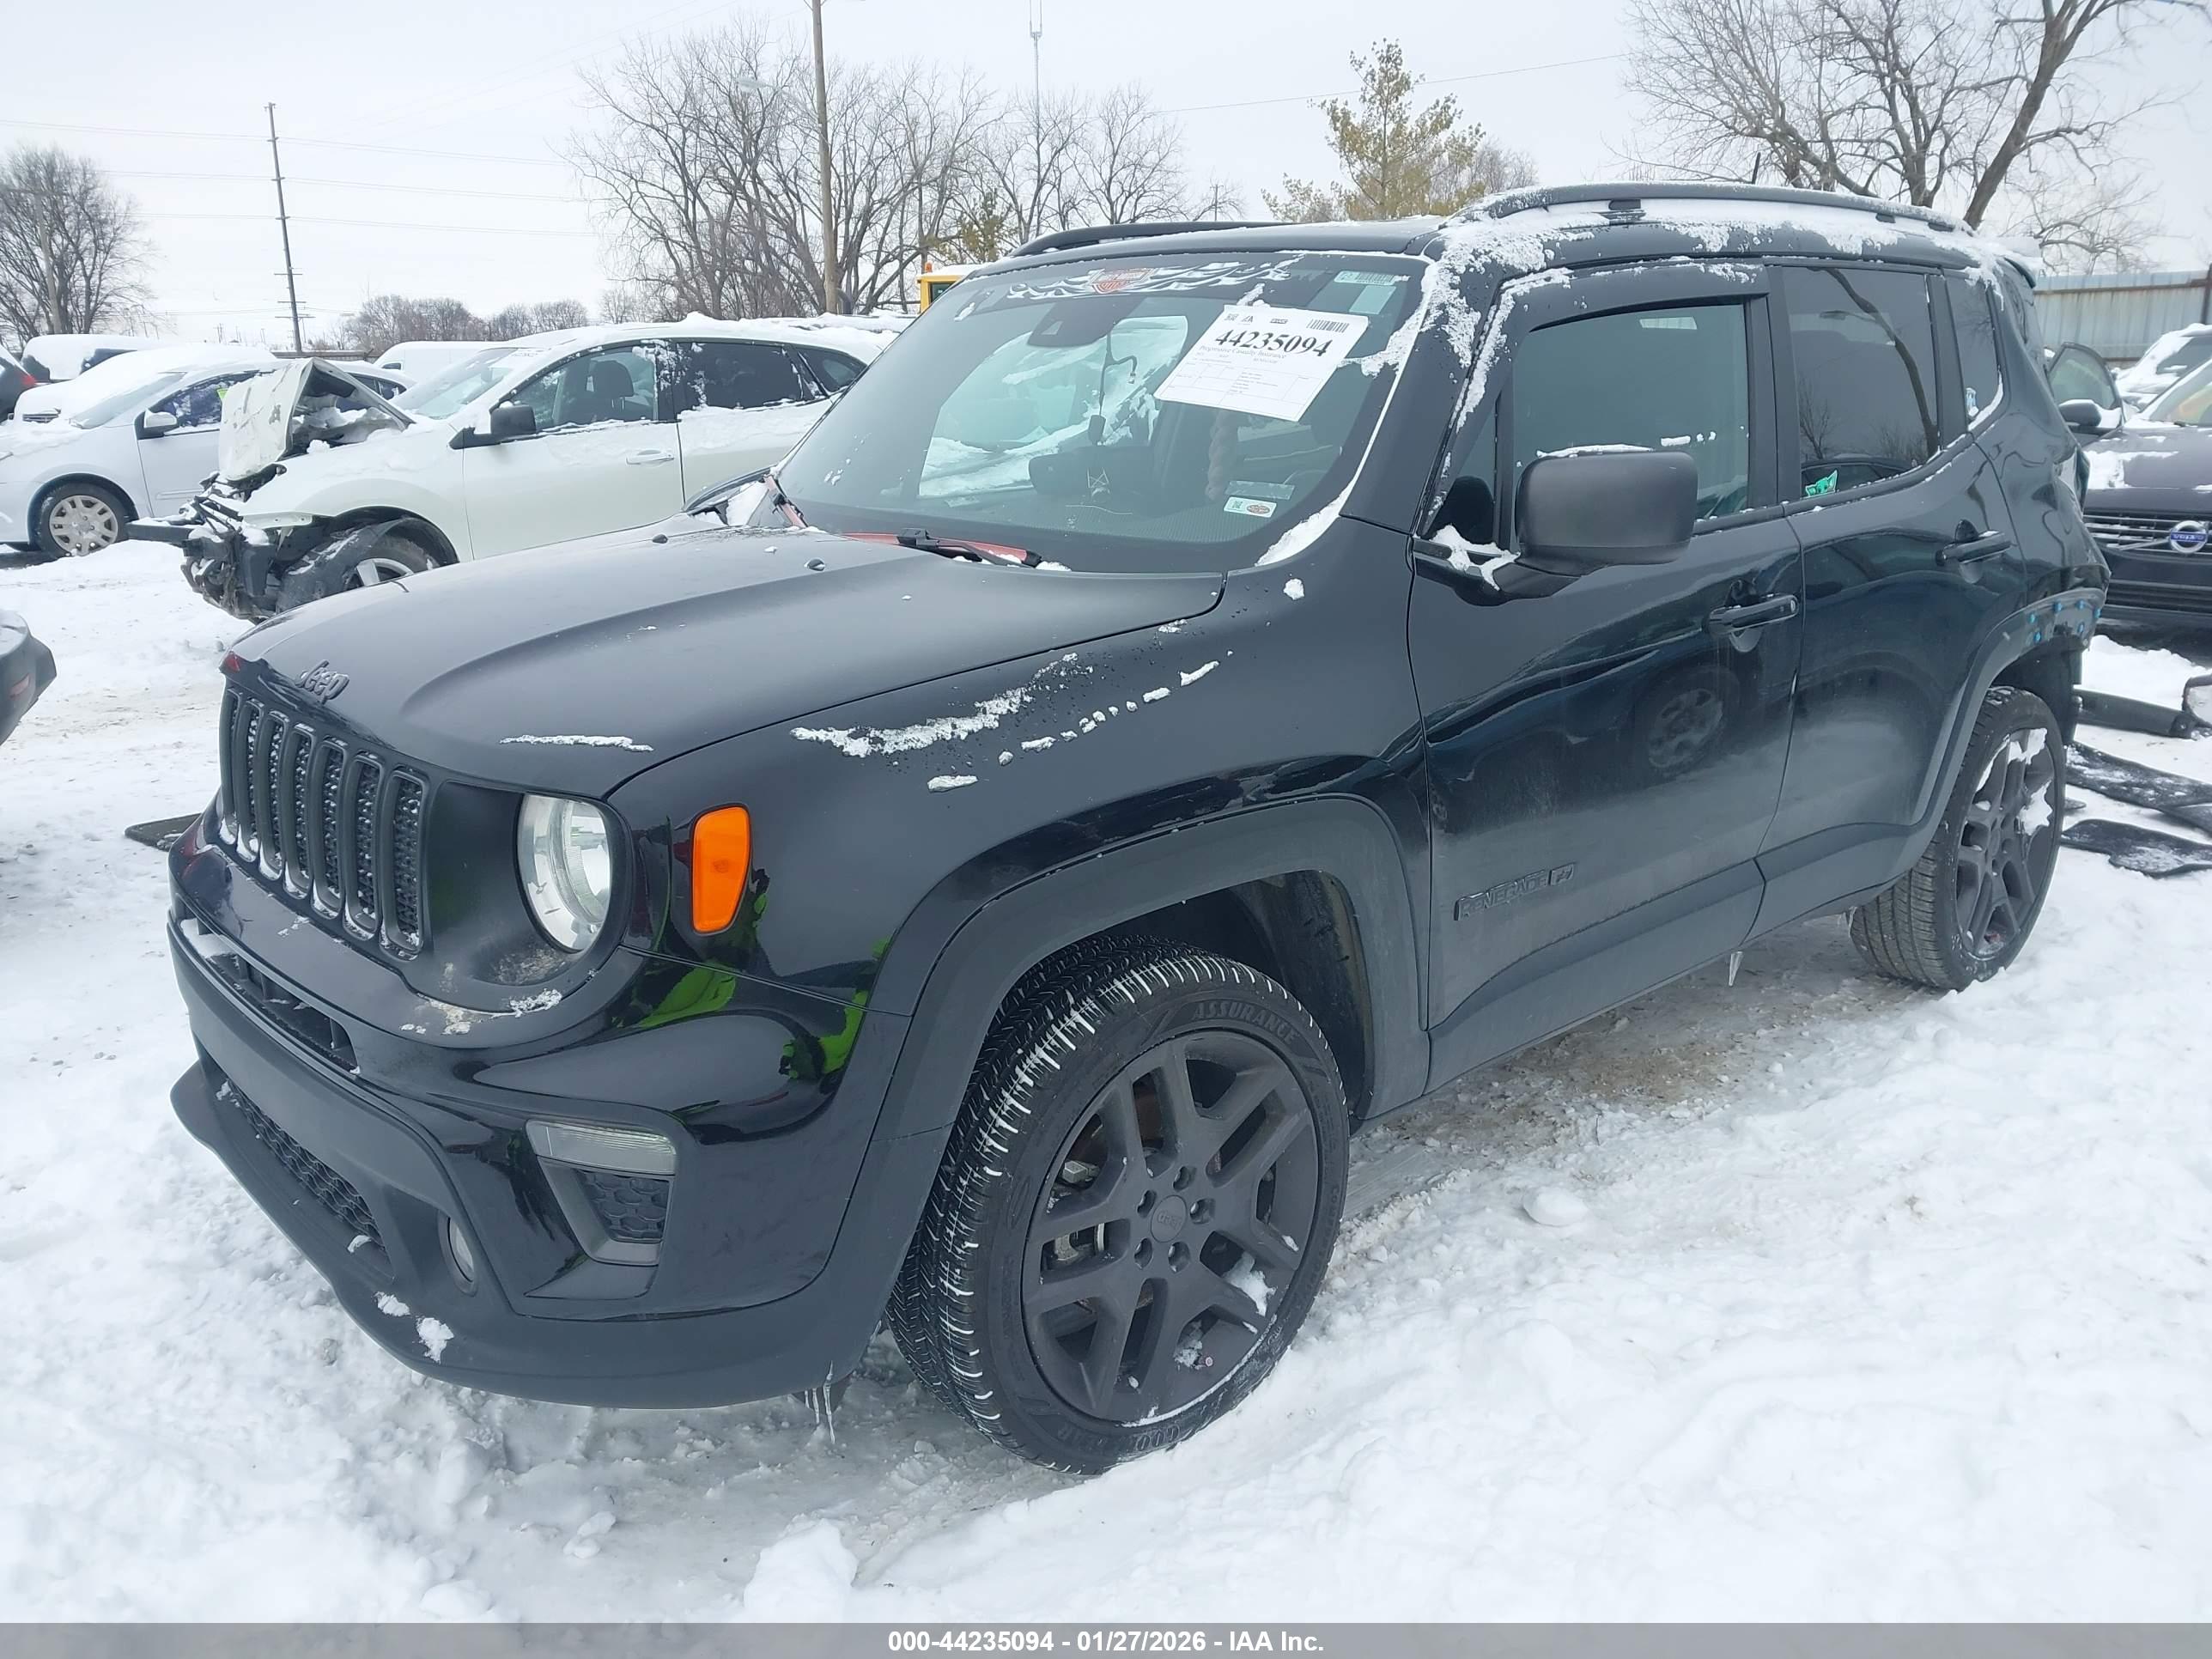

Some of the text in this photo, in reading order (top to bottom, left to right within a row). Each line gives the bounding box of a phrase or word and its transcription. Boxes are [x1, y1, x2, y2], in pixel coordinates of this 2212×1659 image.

[1214, 329, 1334, 357] 44235094
[295, 659, 349, 704] Jeep
[1192, 1000, 1300, 1045] ASSURANCE
